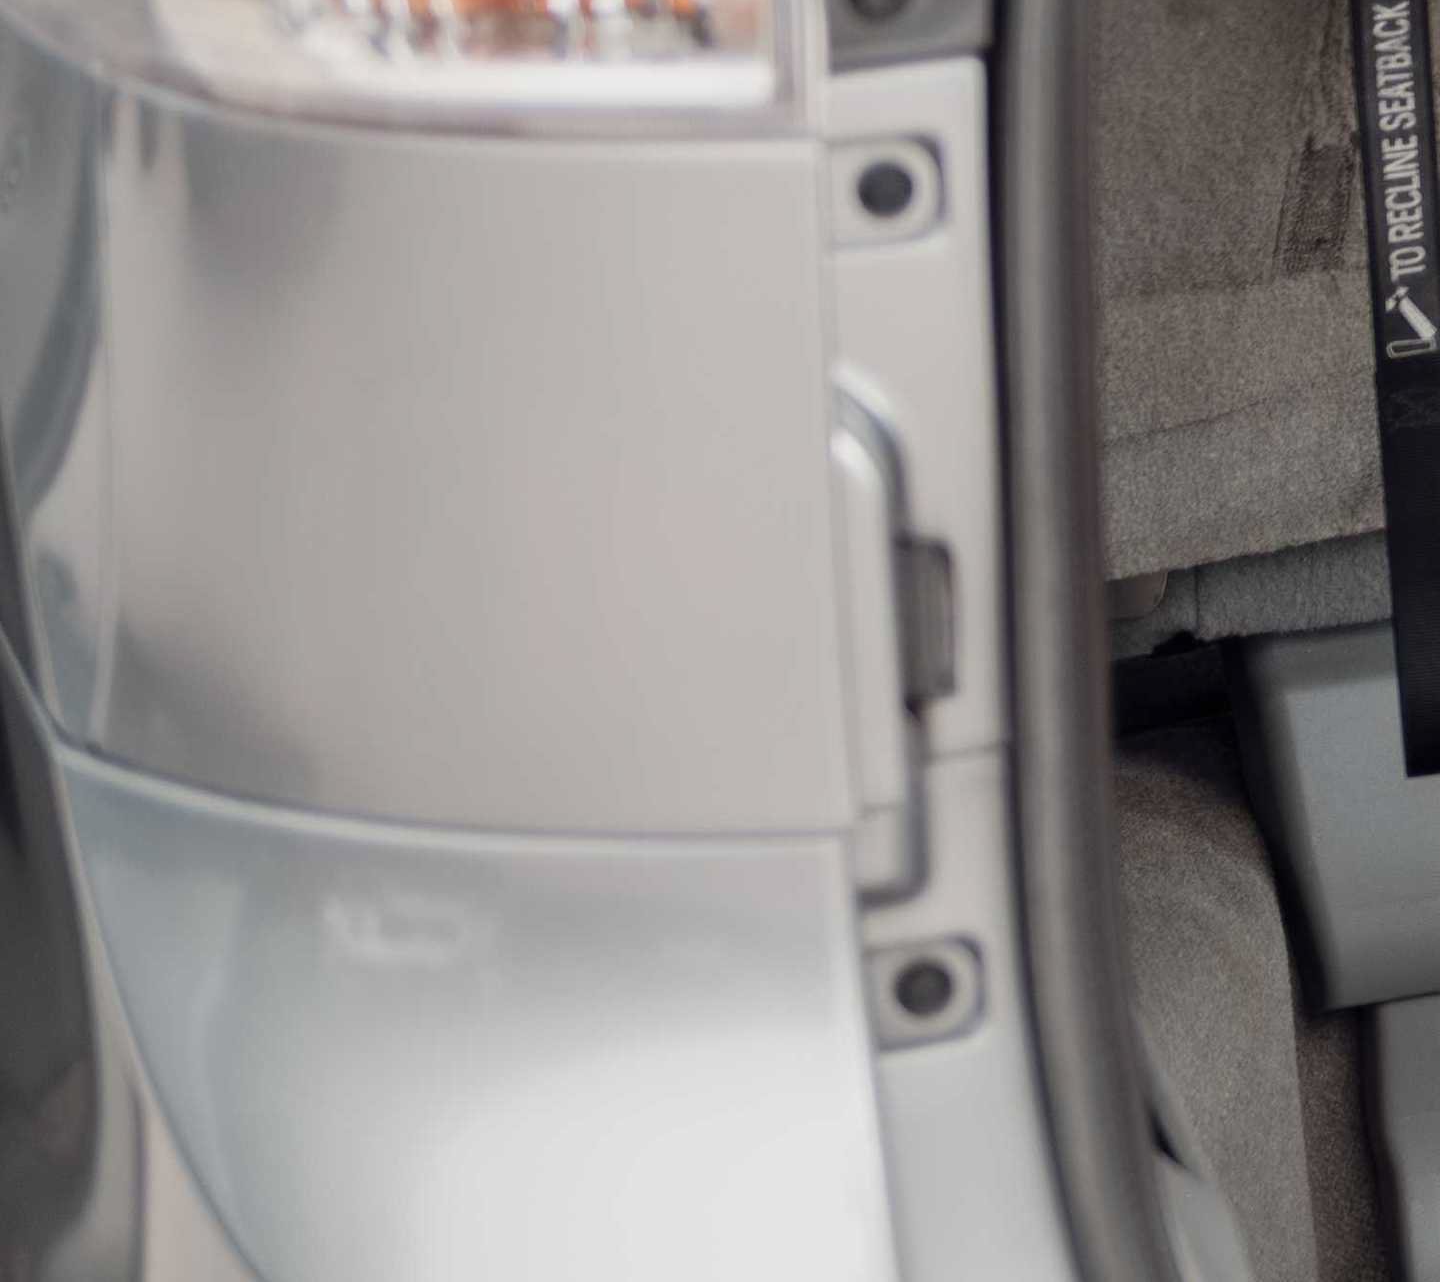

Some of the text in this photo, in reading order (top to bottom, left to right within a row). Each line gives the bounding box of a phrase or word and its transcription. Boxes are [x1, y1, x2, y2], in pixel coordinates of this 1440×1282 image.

[1372, 0, 1426, 281] TO RECLINE SEATBACK
